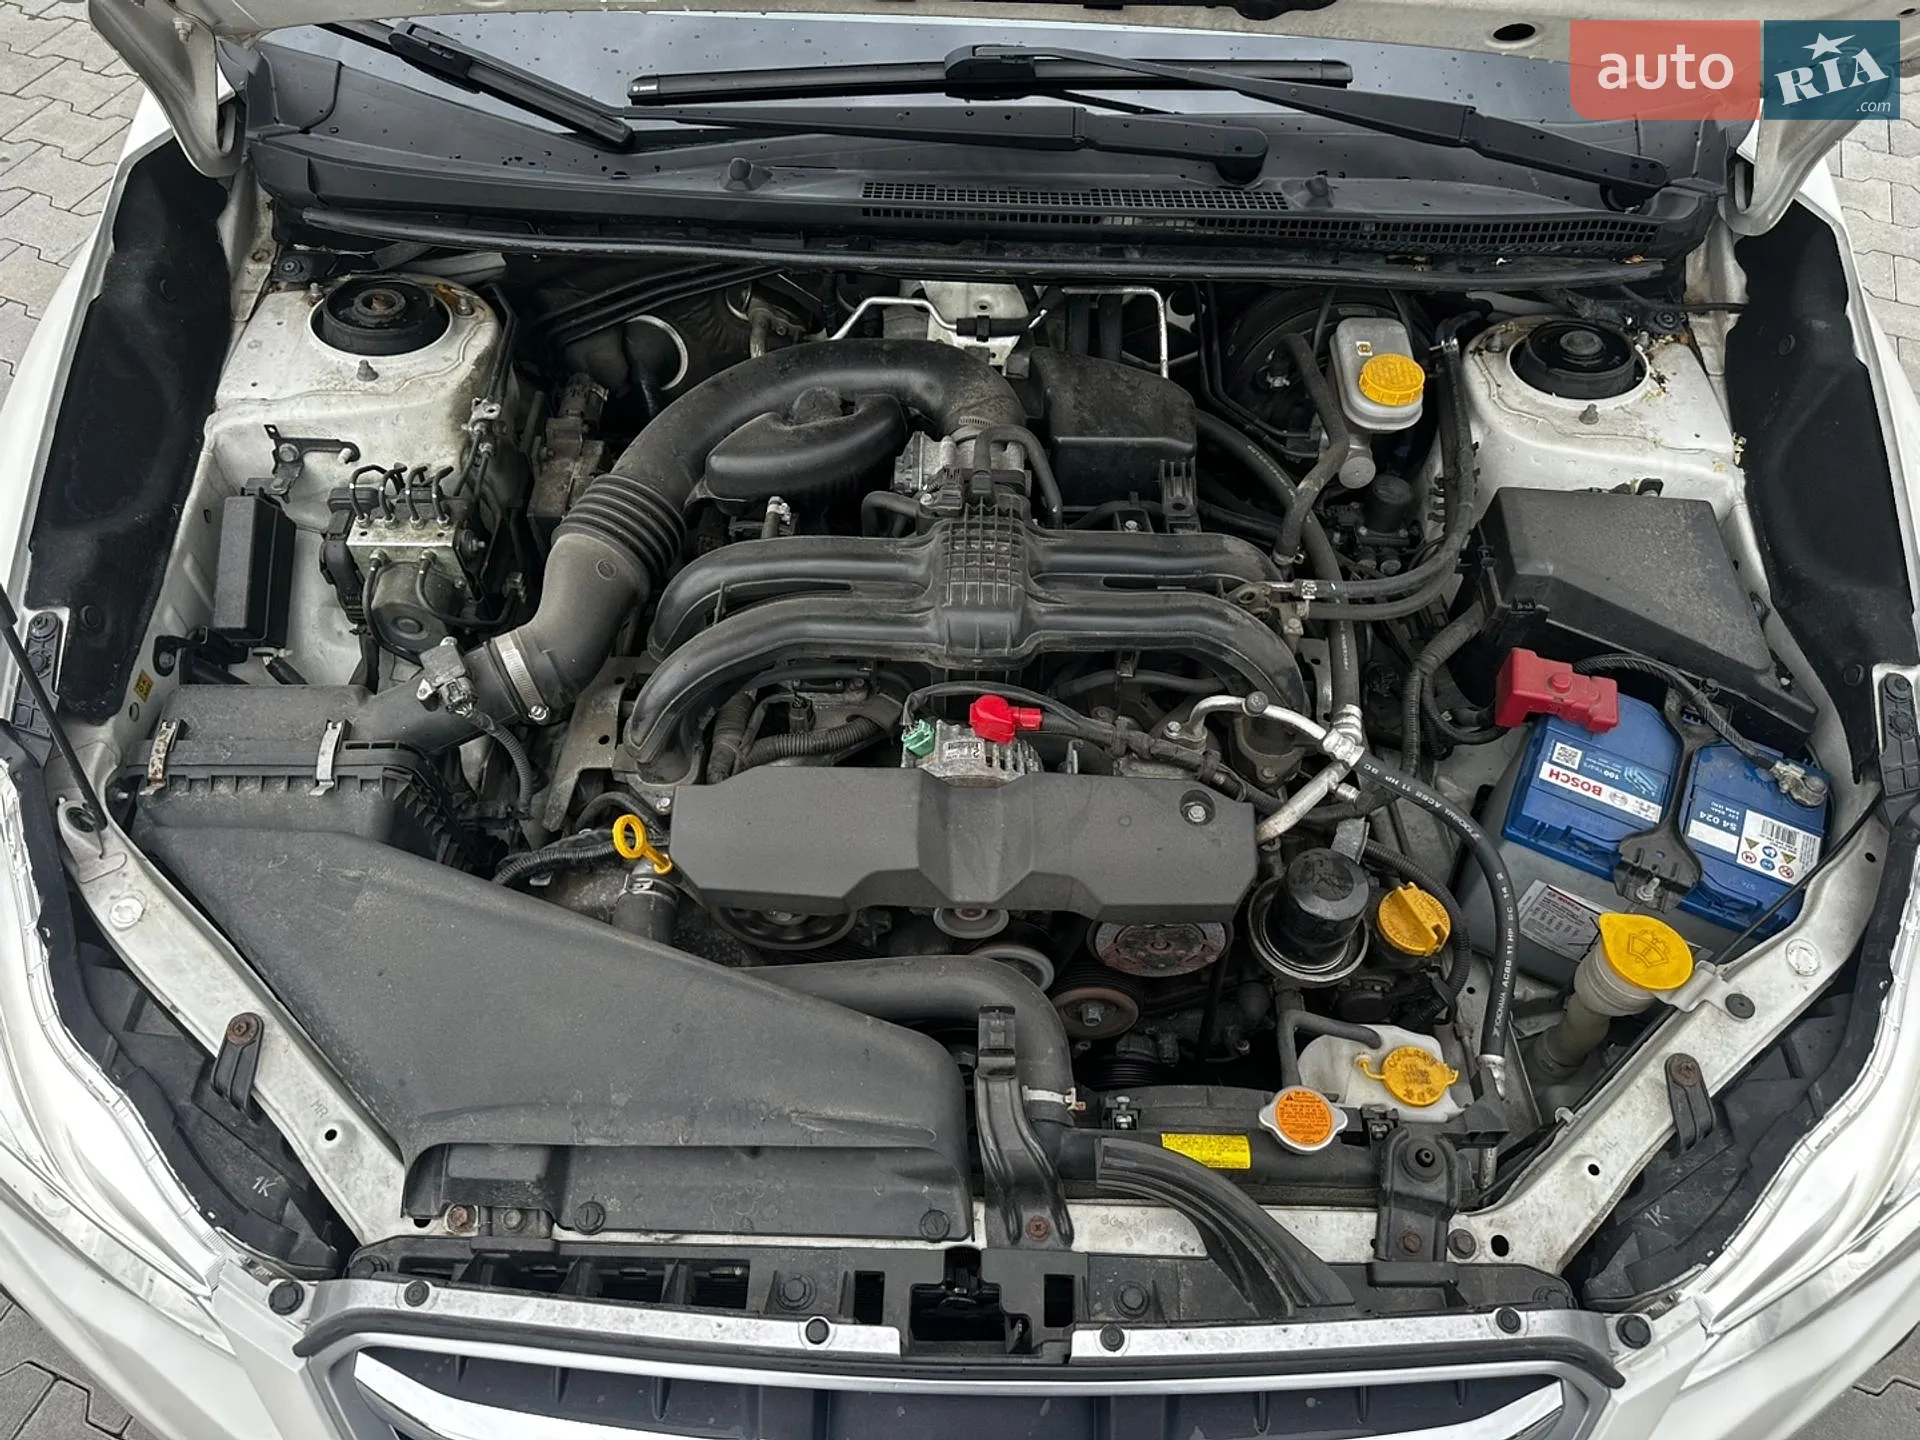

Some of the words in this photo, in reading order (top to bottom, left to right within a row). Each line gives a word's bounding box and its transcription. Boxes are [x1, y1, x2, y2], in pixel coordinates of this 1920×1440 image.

[1548, 767, 1603, 797] BOSCH
[1699, 810, 1720, 825] 024
[252, 1176, 277, 1197] 1K
